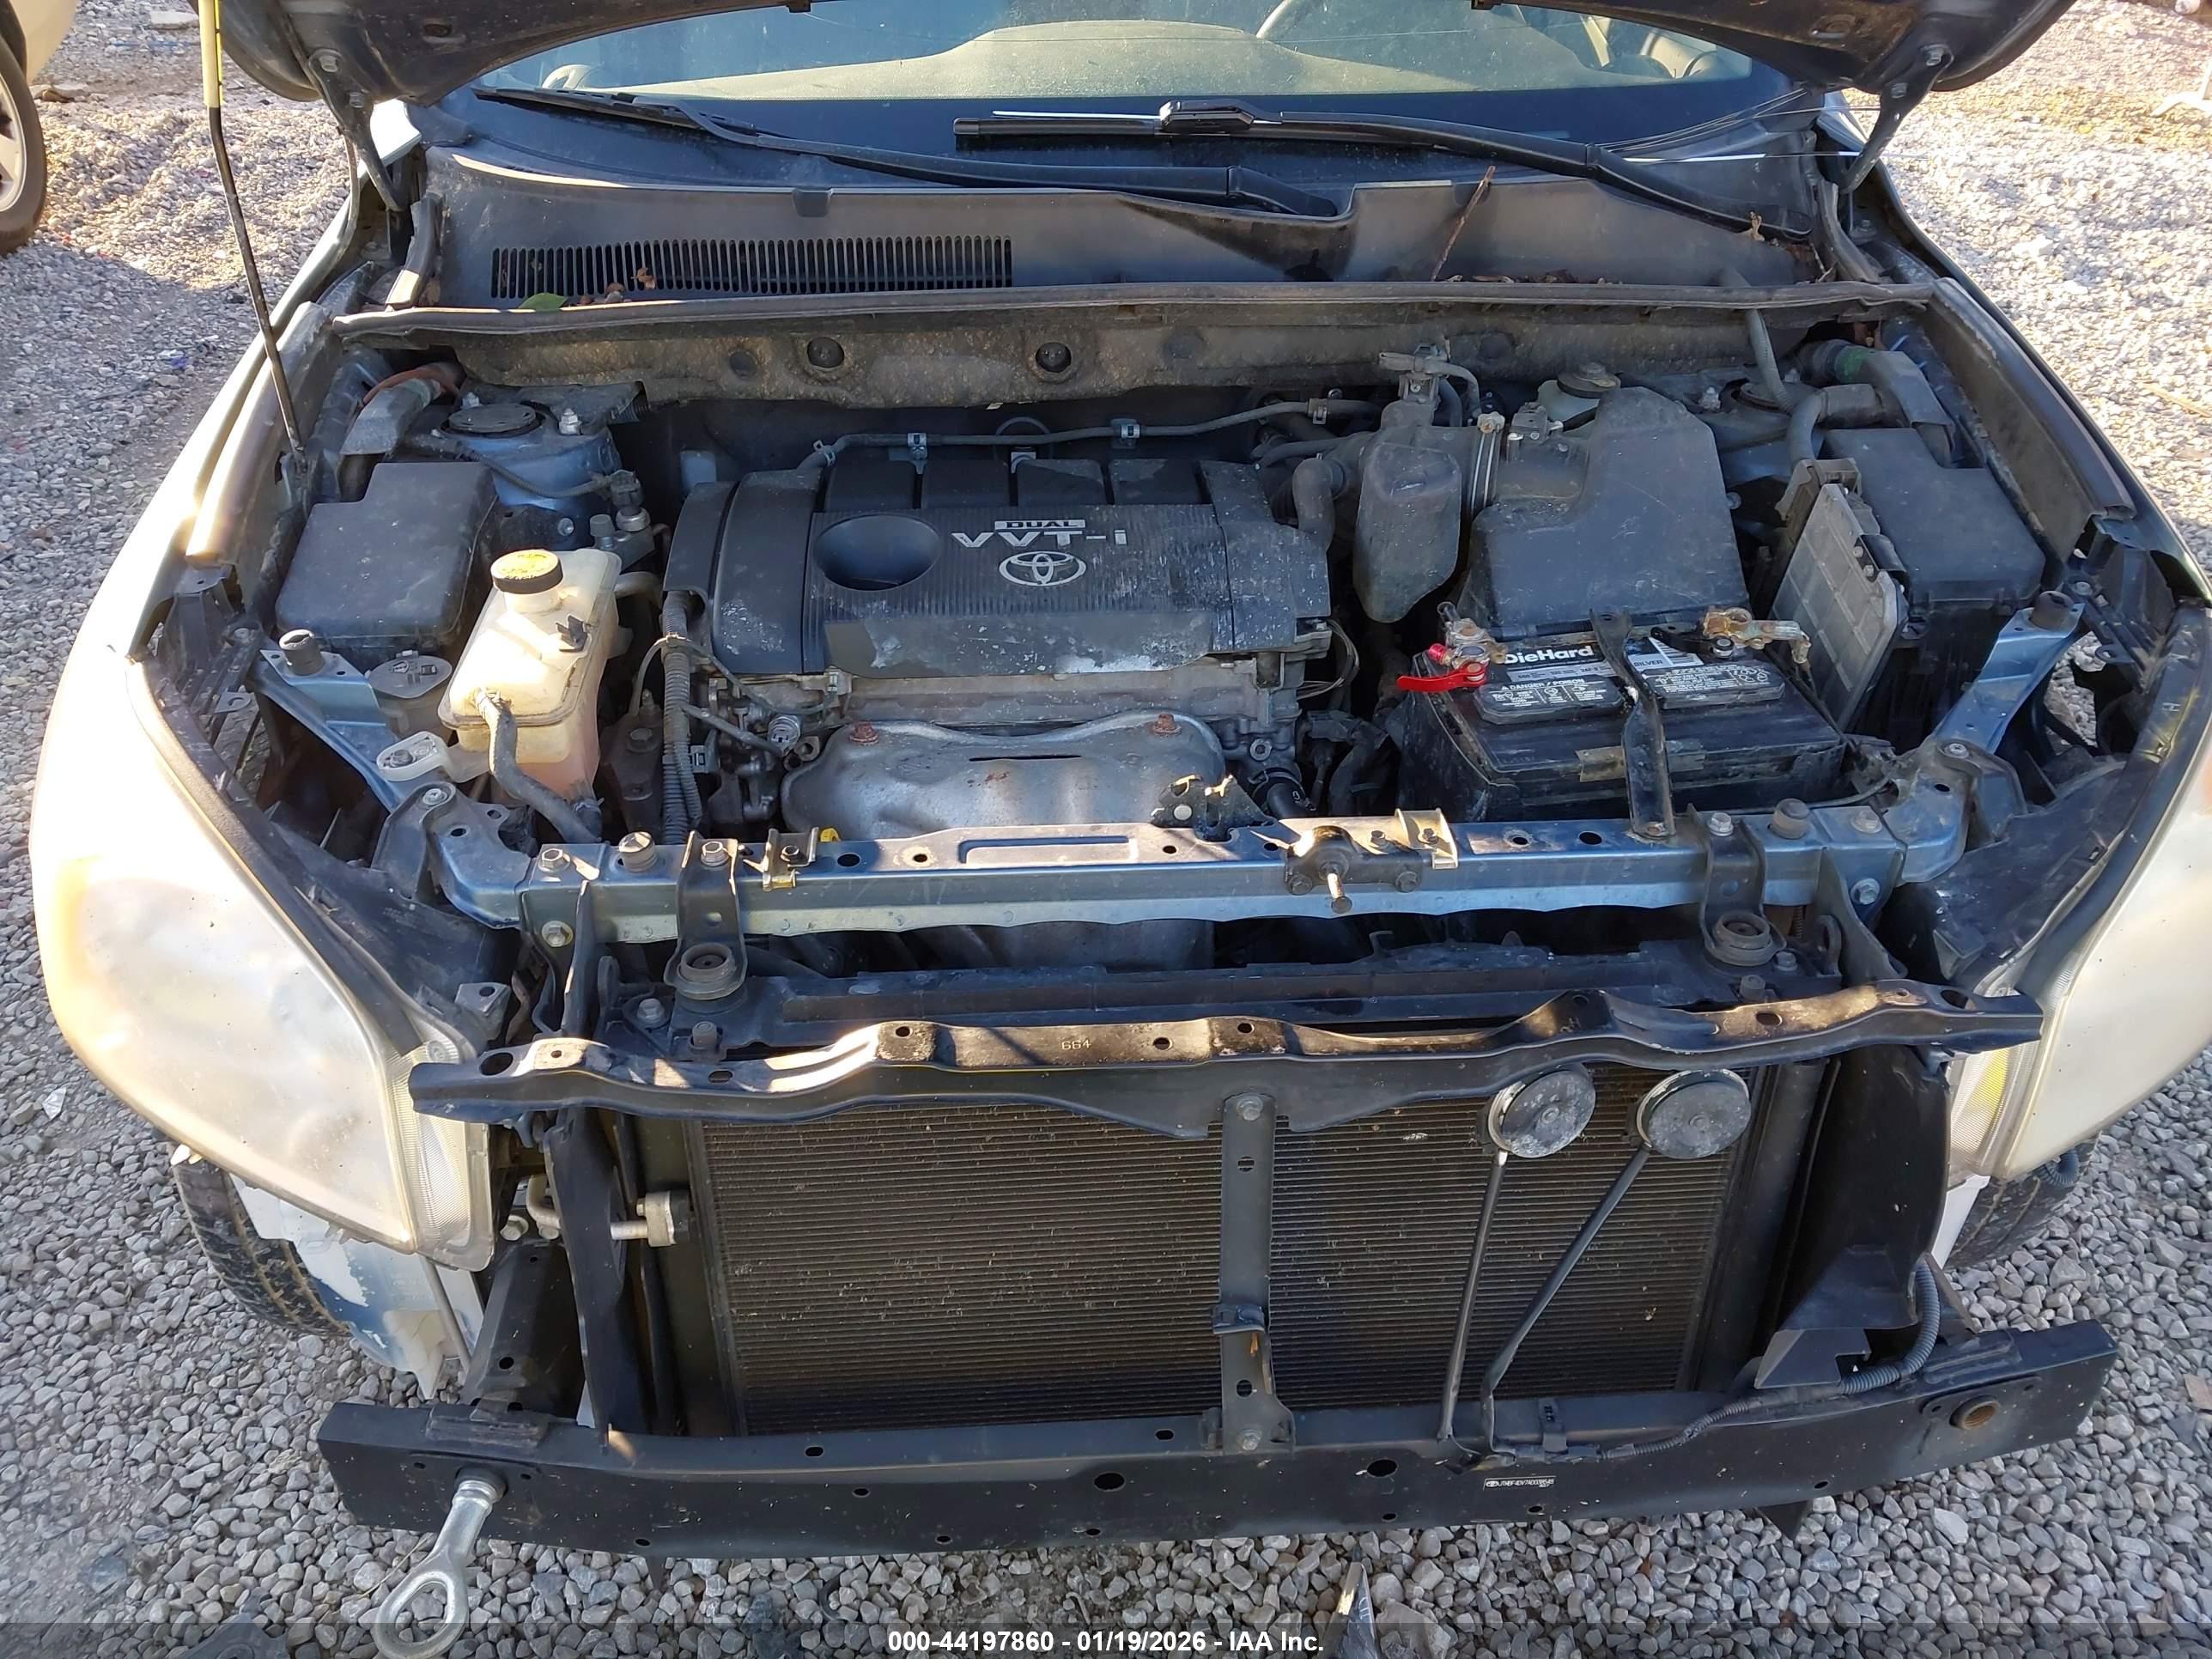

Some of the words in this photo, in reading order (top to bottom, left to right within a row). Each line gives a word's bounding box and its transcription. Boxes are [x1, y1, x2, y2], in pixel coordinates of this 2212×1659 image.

[951, 530, 1127, 548] VVT-i
[1504, 646, 1595, 664] DieHard
[1510, 682, 1544, 690] DANGER
[1061, 1037, 1091, 1050] 664
